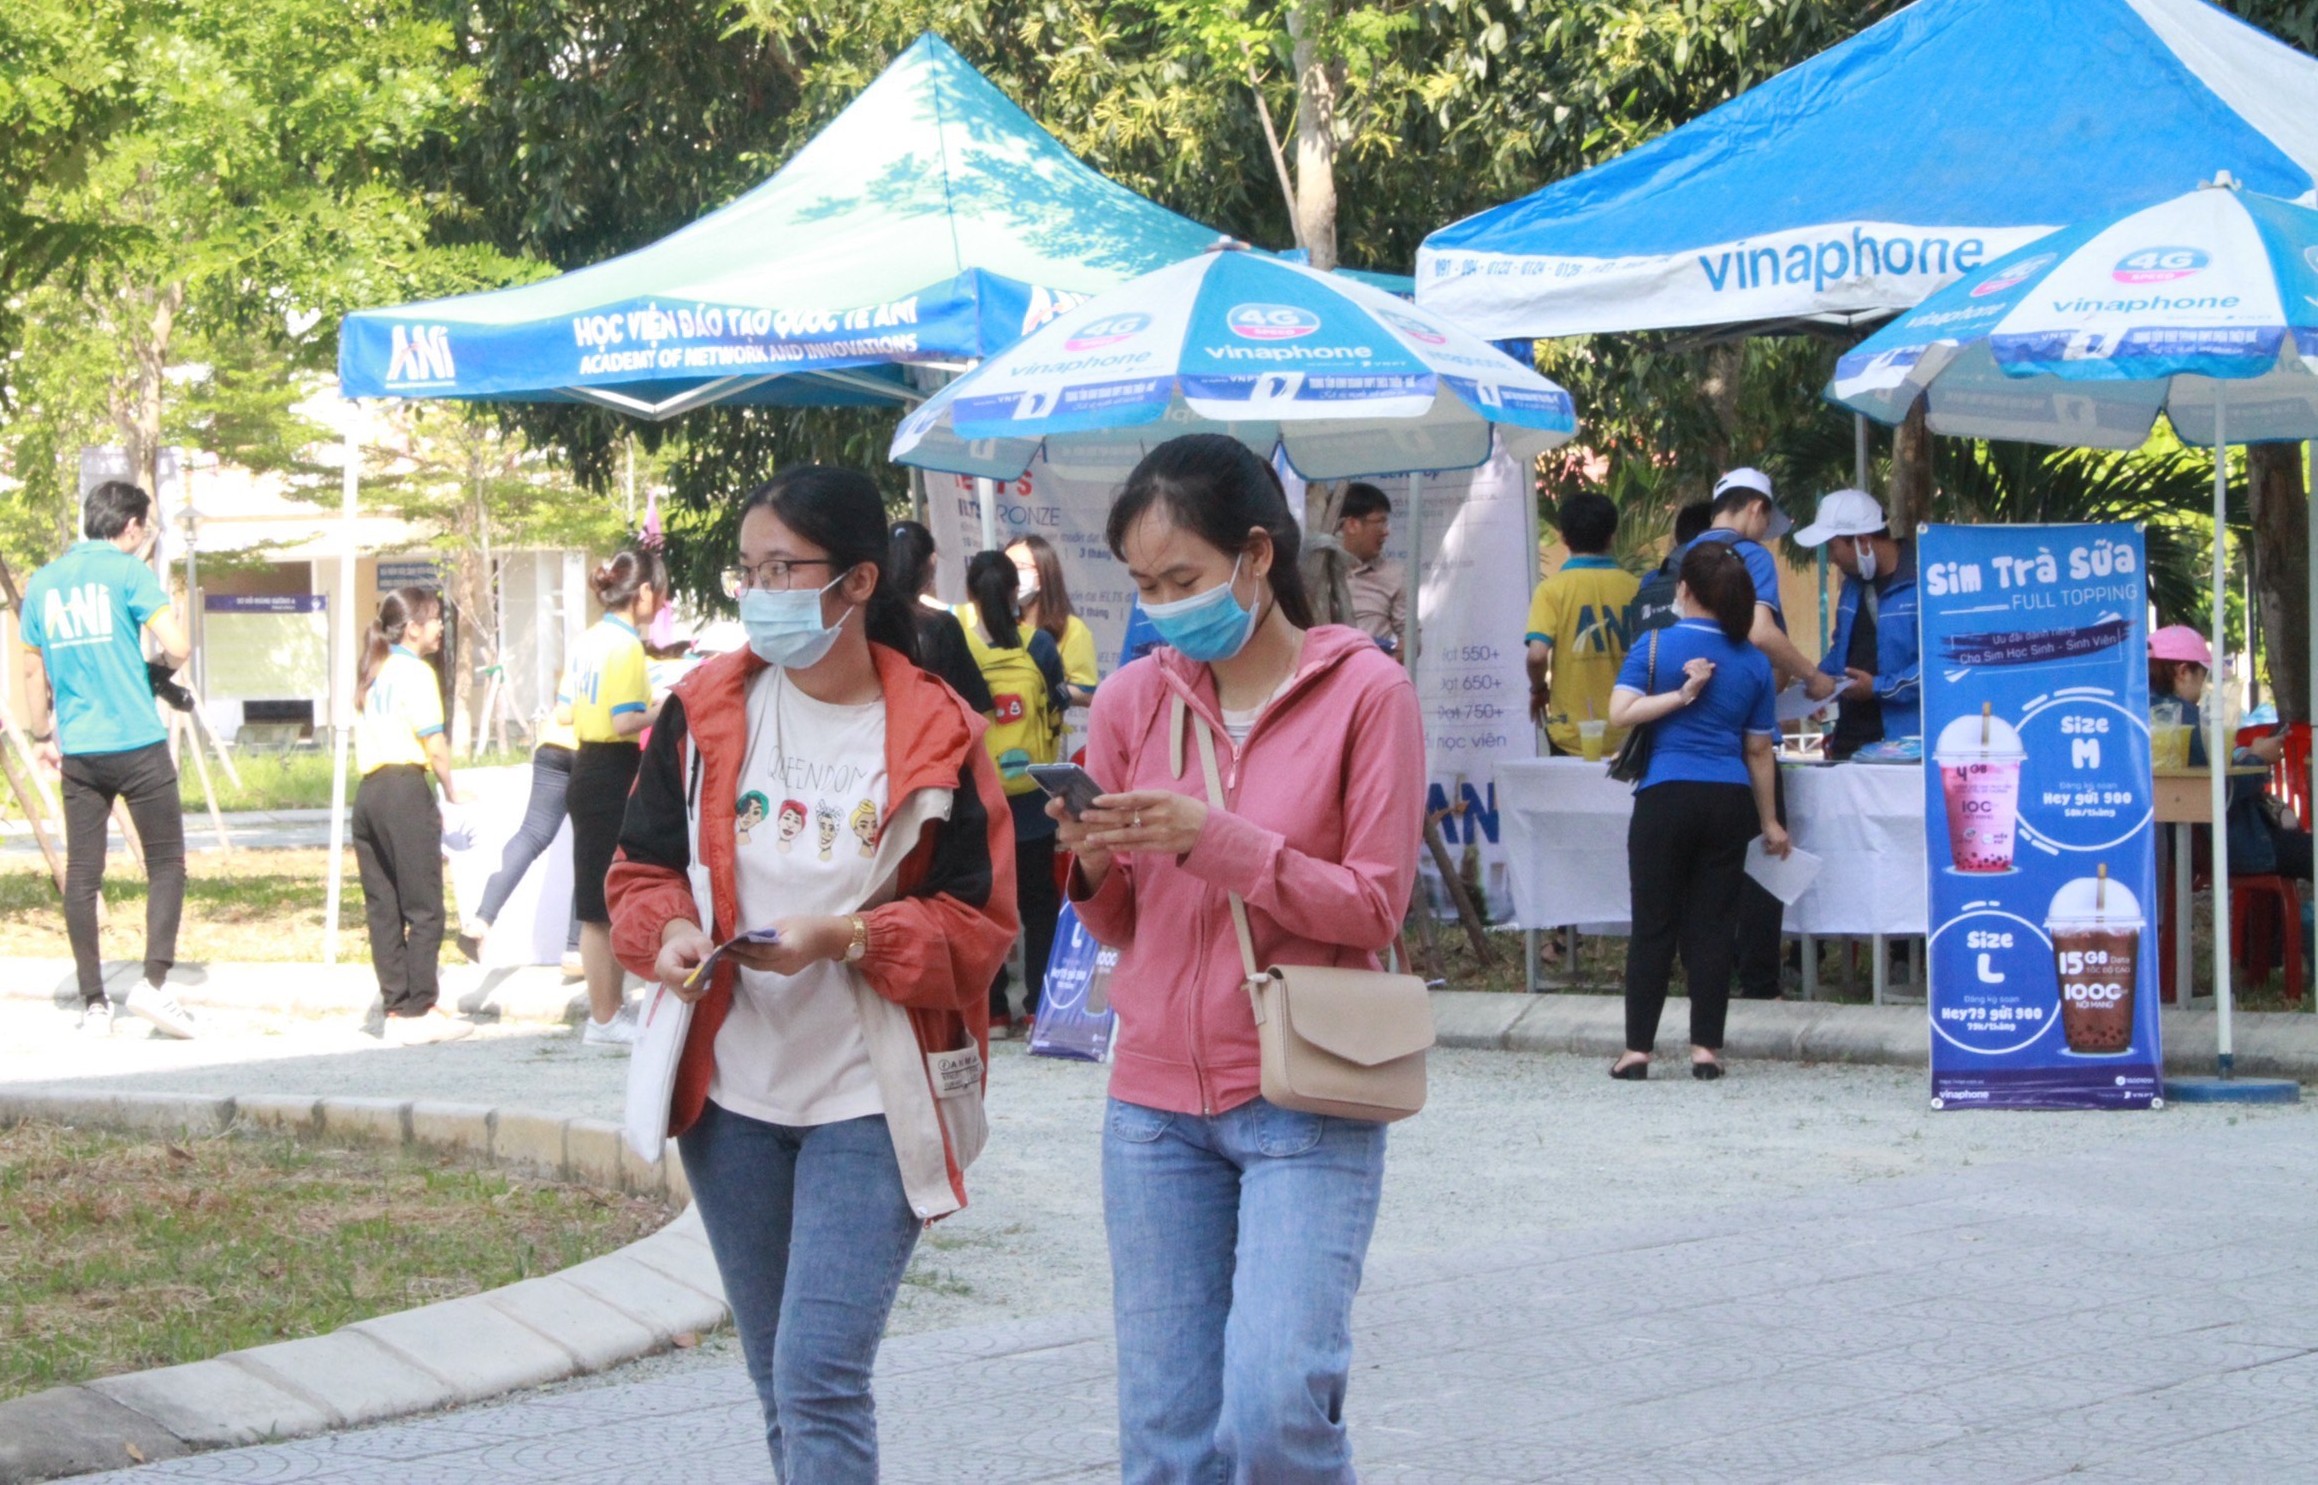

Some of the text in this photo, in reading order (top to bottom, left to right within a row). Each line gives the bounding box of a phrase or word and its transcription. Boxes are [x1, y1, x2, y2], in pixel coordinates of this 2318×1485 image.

[1698, 226, 1984, 293] vinaphone
[2127, 251, 2194, 270] 4G
[2052, 295, 2241, 314] vinaphone
[1237, 309, 1300, 326] 4G
[579, 333, 919, 375] ACADEMY OF NETWORK AND INNOVATIONS
[1204, 344, 1373, 361] vinaphone
[1010, 350, 1153, 378] vinaphone
[995, 504, 1061, 526] RONZE
[1926, 539, 2136, 596] Sim Trà Sữa
[2013, 584, 2138, 610] FULL TOPPING
[1462, 645, 1500, 661] 550+
[1960, 653, 1981, 664] Cho
[1984, 650, 2004, 662] Sim
[2031, 643, 2054, 656] Sinh
[2066, 638, 2090, 651] Sinh
[2093, 634, 2117, 647] Viên
[1462, 674, 1502, 690] 650+
[1464, 703, 1504, 719] 750+
[2060, 715, 2109, 734] Size
[1471, 731, 1507, 749] viên
[2070, 738, 2101, 769] M
[2103, 791, 2133, 806] 900
[1966, 930, 2014, 949] Size
[1977, 953, 2005, 984] L
[1941, 1004, 2043, 1021] Hey79 gửi 900
[1939, 1088, 1990, 1100] vinaphone
